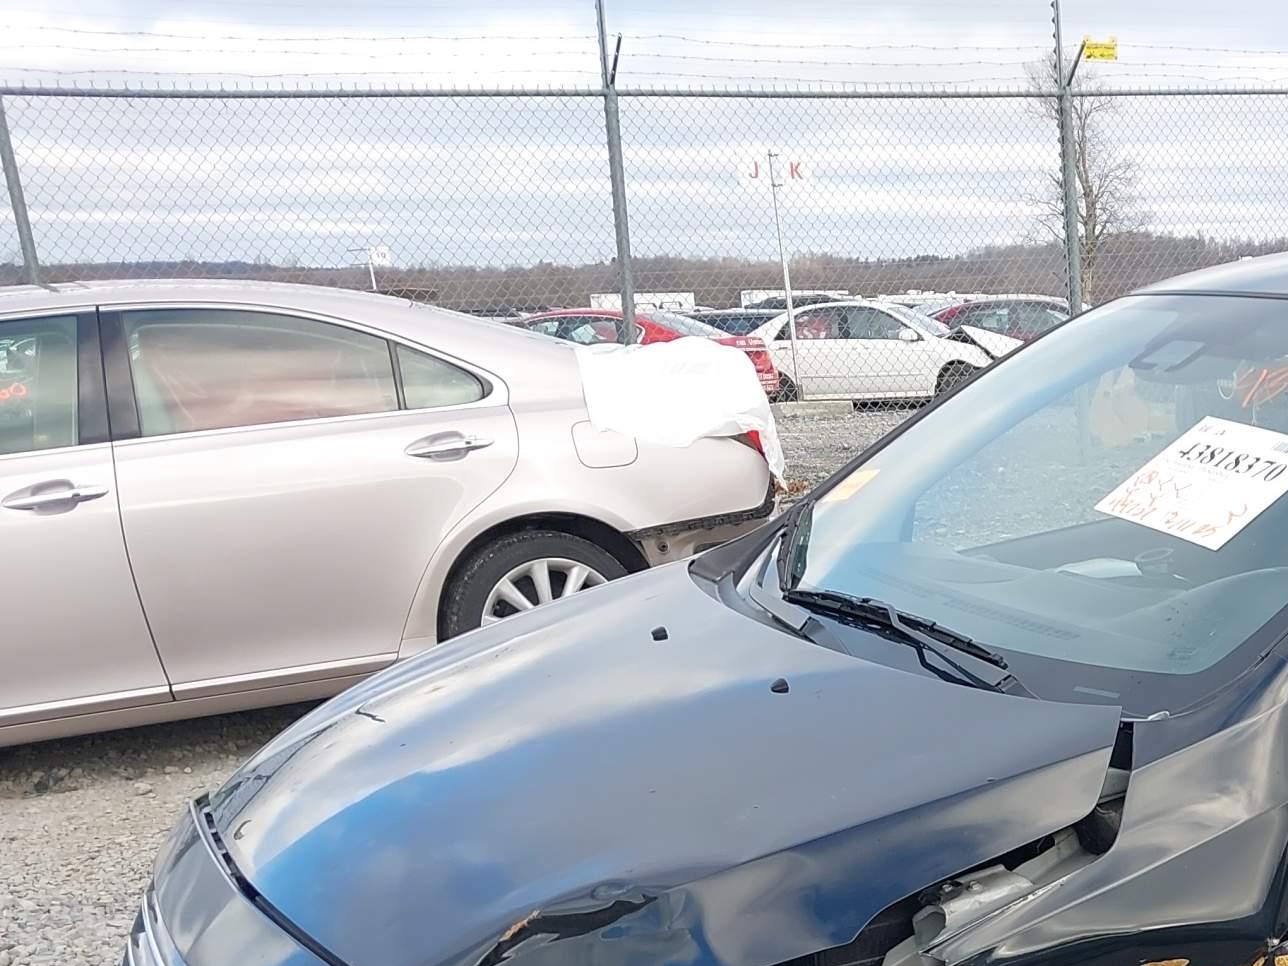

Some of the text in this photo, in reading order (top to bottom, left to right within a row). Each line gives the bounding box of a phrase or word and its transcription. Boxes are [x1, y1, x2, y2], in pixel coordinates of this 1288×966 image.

[748, 161, 759, 179] J
[789, 161, 803, 180] K
[1179, 442, 1288, 482] 43818370
